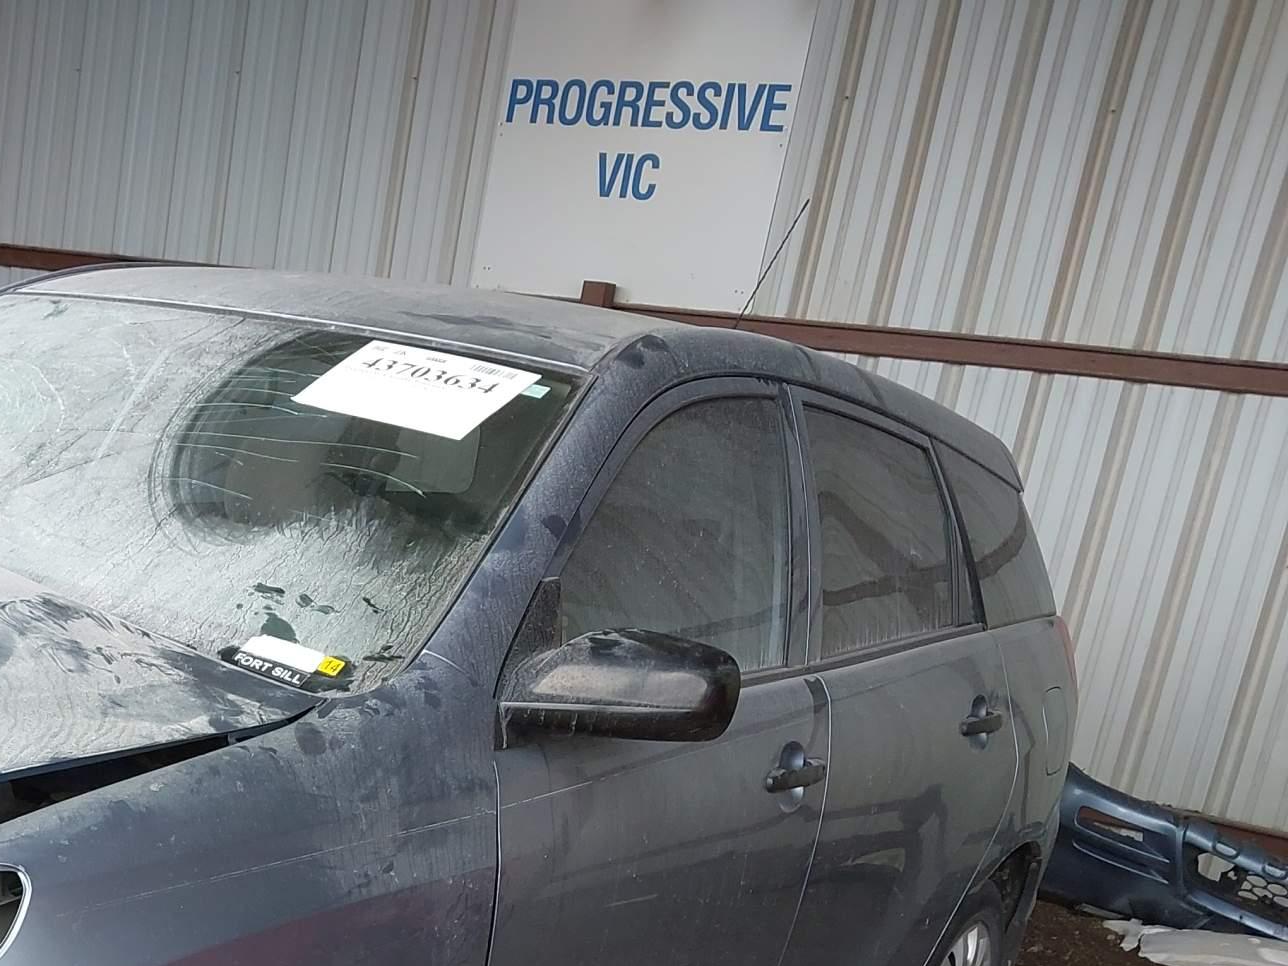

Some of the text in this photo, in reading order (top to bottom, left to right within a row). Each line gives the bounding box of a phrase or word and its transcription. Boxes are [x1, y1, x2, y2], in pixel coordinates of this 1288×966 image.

[505, 78, 793, 133] PROGRESSIVE
[598, 151, 661, 201] VIC
[361, 356, 500, 394] 43703634
[234, 652, 301, 684] FORT SILL
